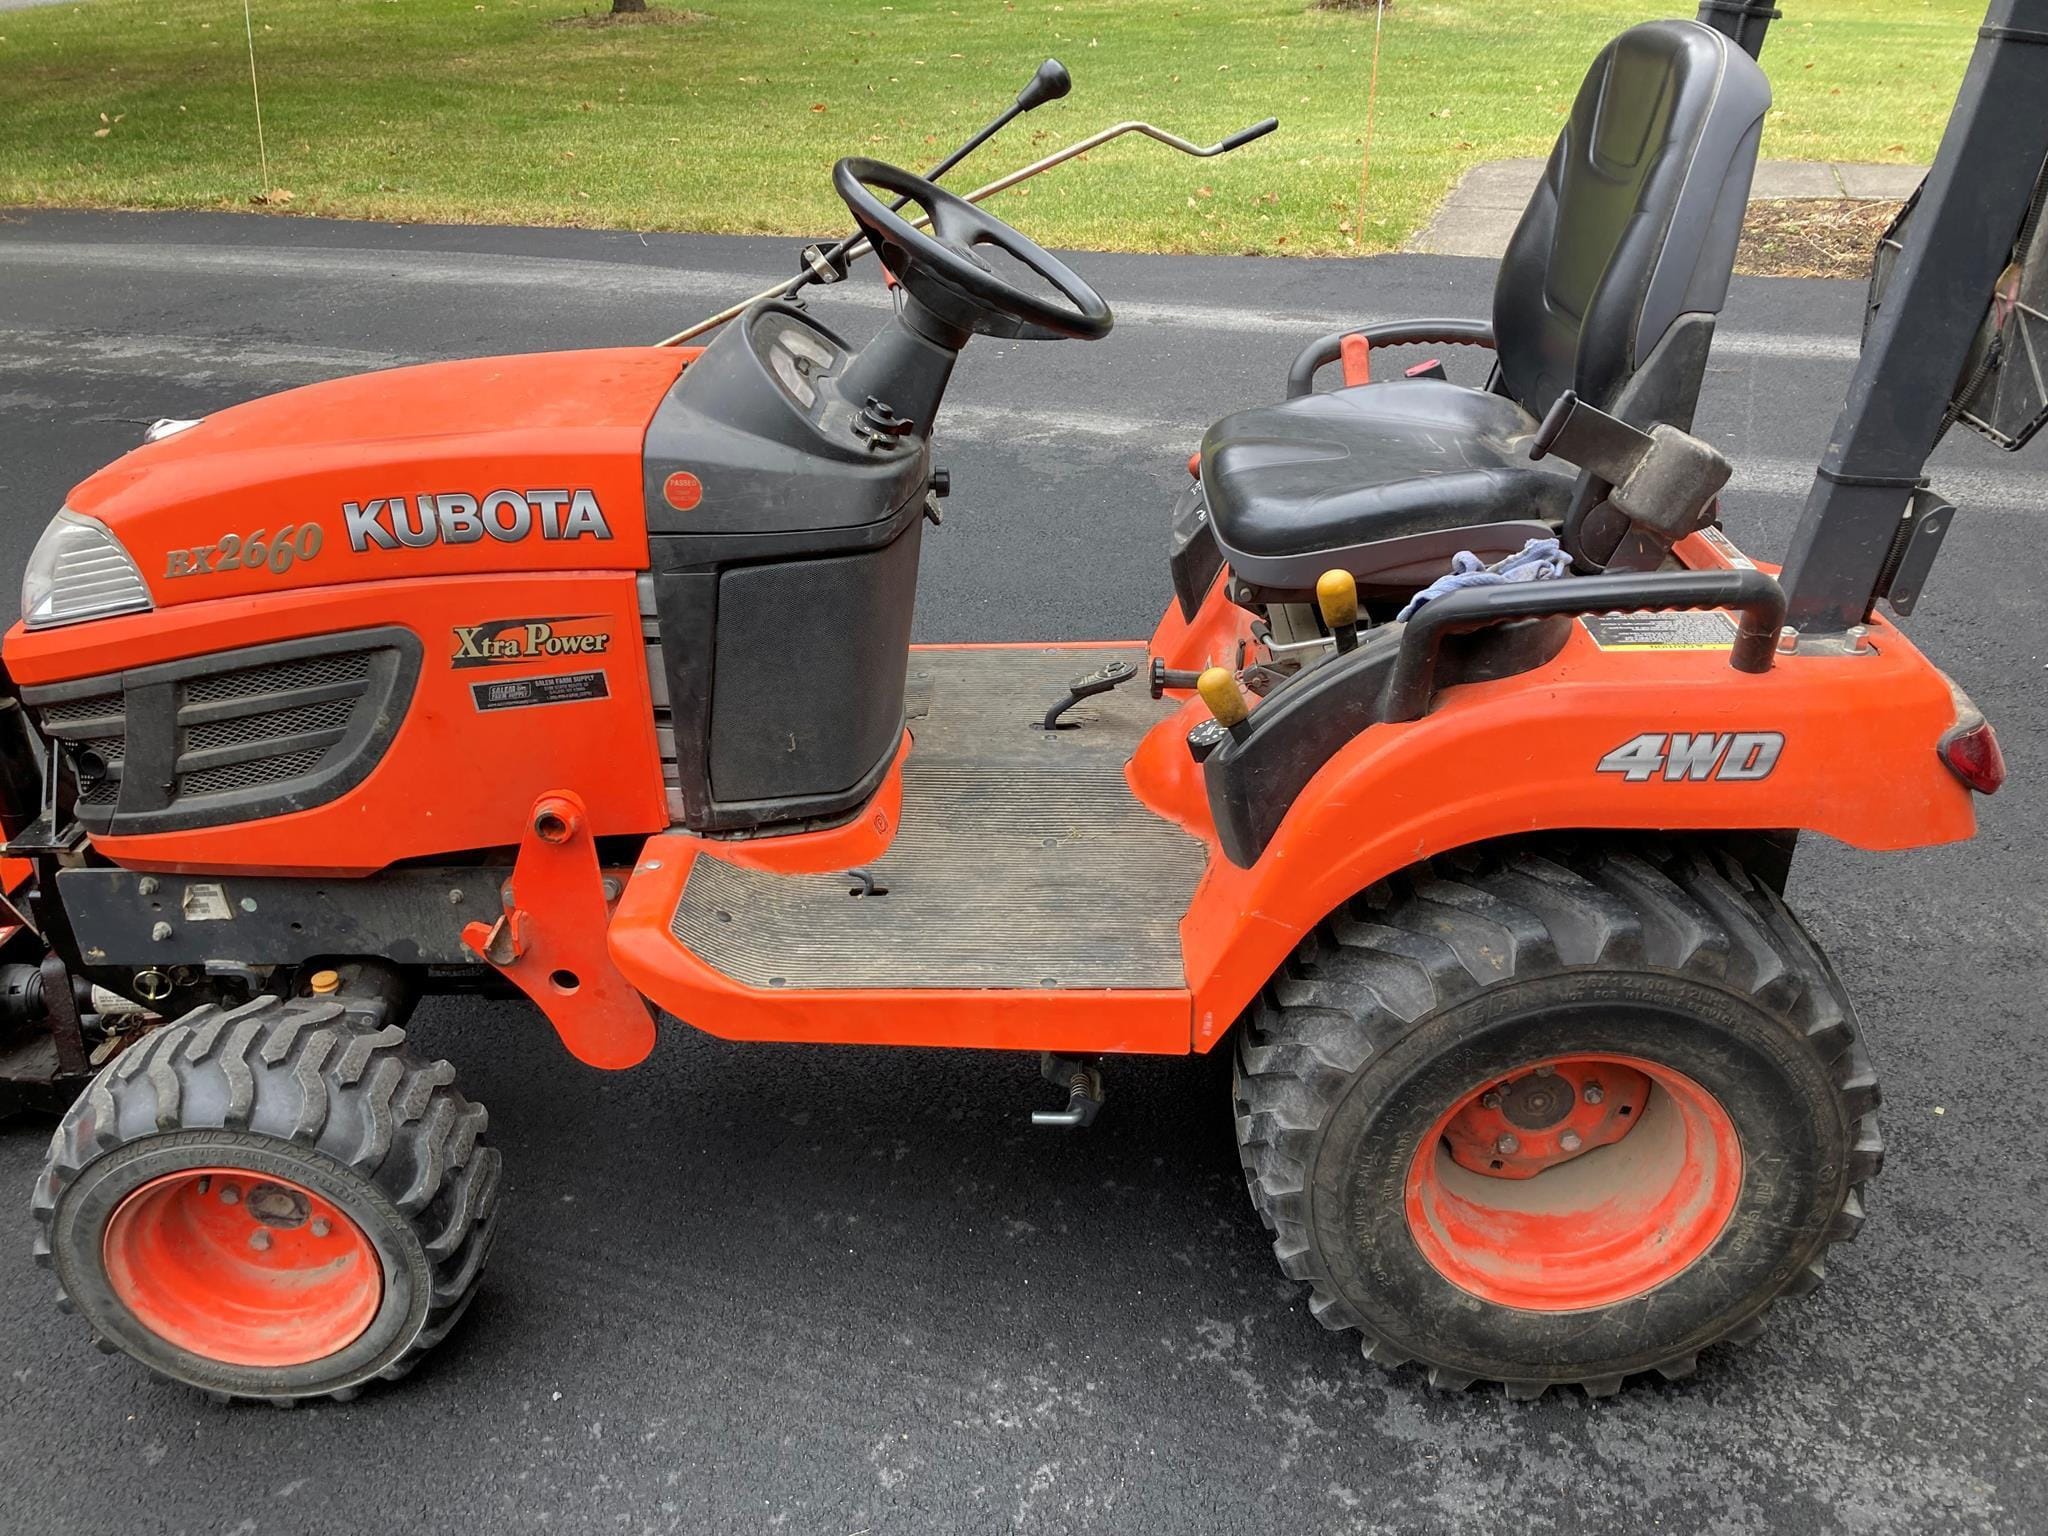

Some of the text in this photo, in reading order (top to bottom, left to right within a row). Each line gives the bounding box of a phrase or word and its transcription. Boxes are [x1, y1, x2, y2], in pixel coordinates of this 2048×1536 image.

[342, 488, 616, 552] KUBOTA
[162, 521, 323, 579] BX2660
[453, 623, 609, 659] Xtra Power
[491, 685, 516, 694] SALEM
[491, 690, 529, 700] FARM SUPPLY
[535, 679, 554, 687] SALEM
[555, 677, 572, 685] FARM
[1595, 731, 1786, 782] 4WD
[100, 1132, 273, 1174] TRACTION
[279, 1140, 410, 1232] MASTER
